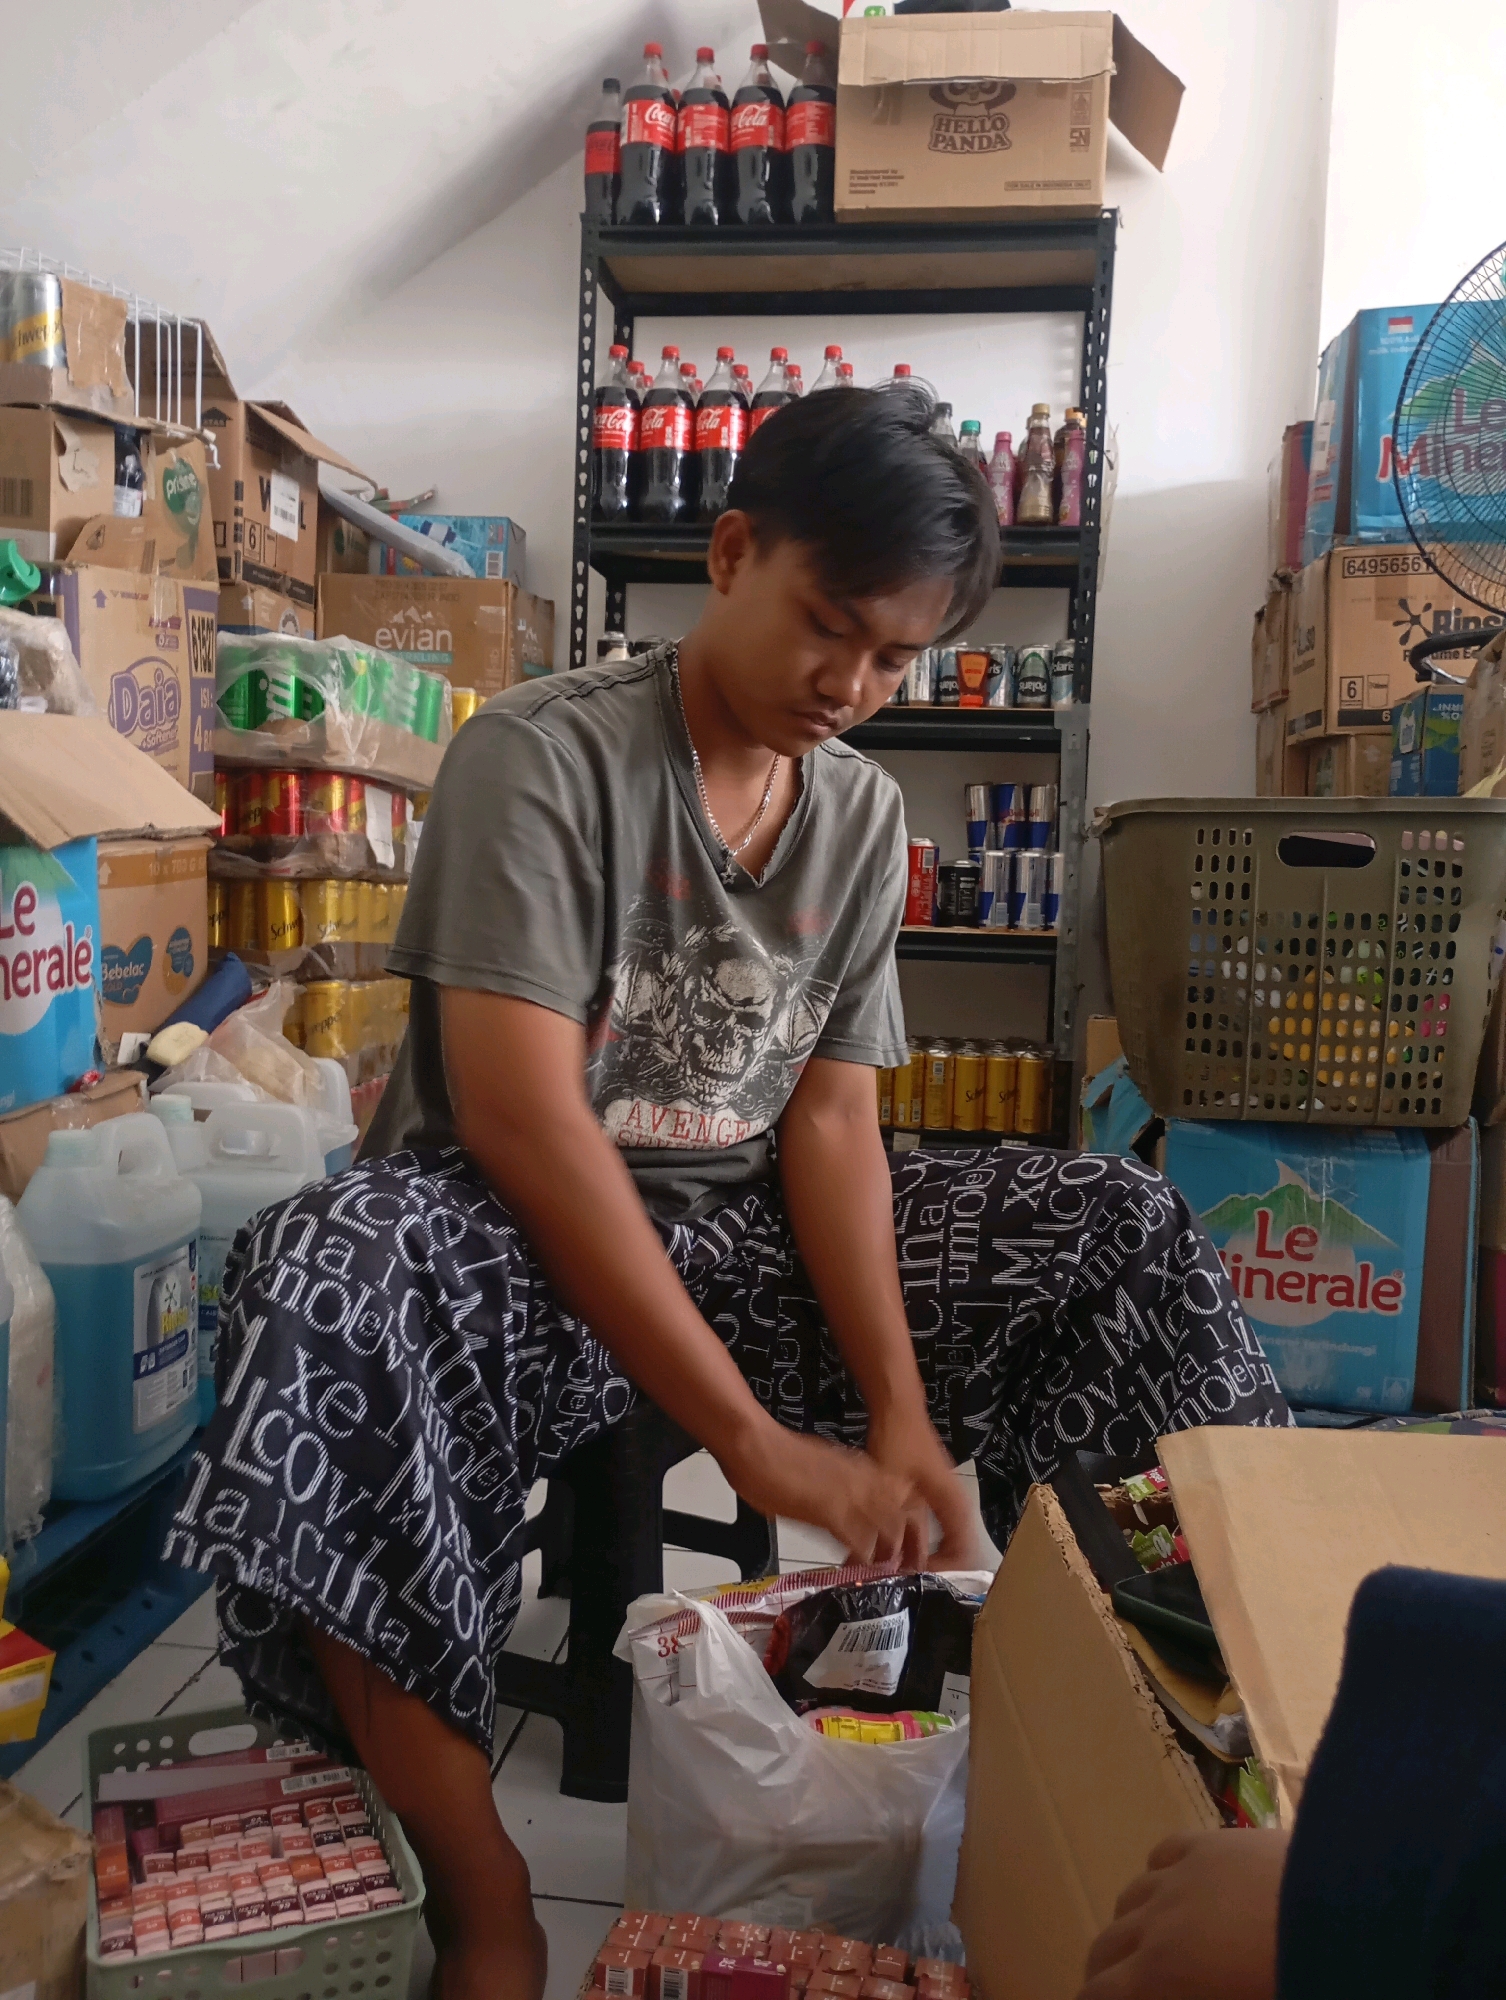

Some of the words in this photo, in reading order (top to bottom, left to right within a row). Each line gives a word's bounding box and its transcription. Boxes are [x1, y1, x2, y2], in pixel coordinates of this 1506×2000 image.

[935, 115, 1007, 134] HELLO
[932, 133, 1010, 150] PANDA
[249, 524, 256, 550] 6
[375, 623, 453, 651] evian
[112, 667, 182, 737] Daia
[1347, 680, 1357, 699] 6
[1256, 1210, 1319, 1262] Le
[1218, 1250, 1402, 1312] inerale
